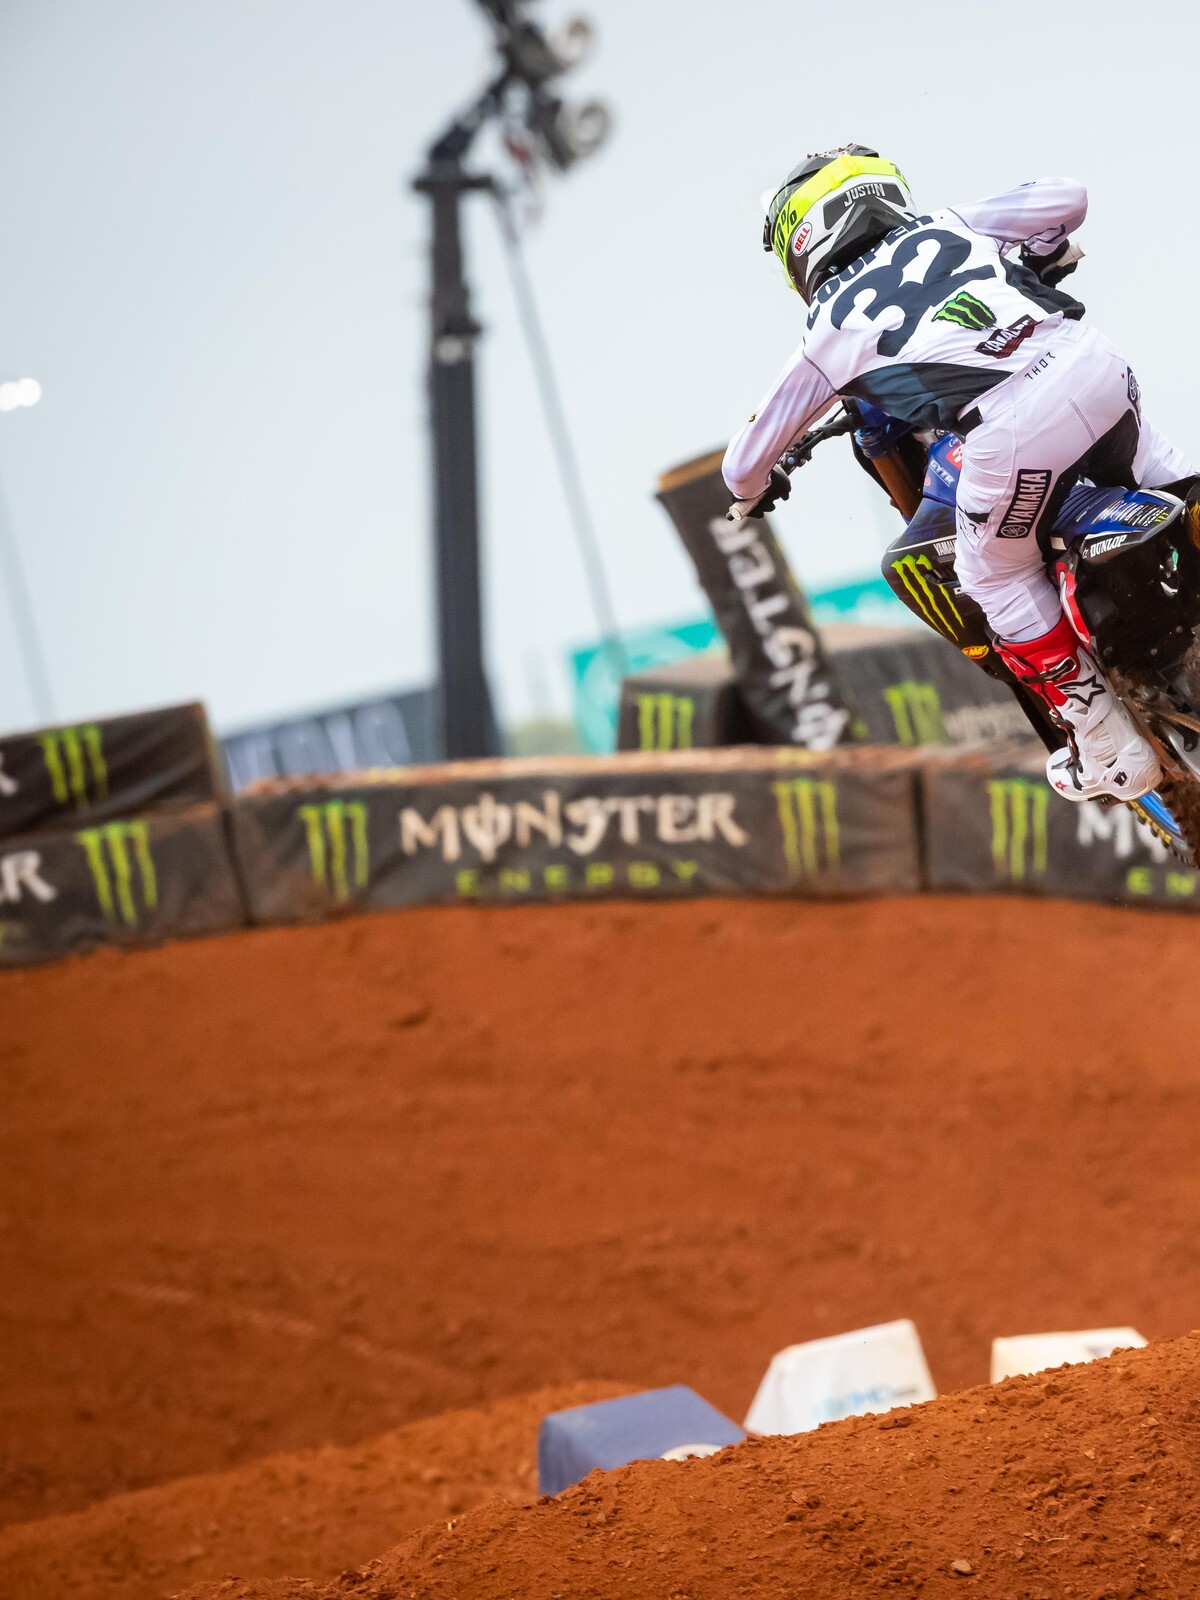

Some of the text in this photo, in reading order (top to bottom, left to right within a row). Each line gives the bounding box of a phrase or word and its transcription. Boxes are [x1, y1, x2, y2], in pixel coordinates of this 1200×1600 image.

[844, 184, 886, 207] JUSTIN
[795, 227, 810, 251] BELL
[831, 228, 997, 356] 32
[1024, 352, 1056, 380] THOR
[930, 458, 955, 486] GYTR
[1005, 472, 1047, 523] YAMAHA
[1090, 534, 1128, 558] DUNLOP
[401, 791, 748, 862] MONSTER
